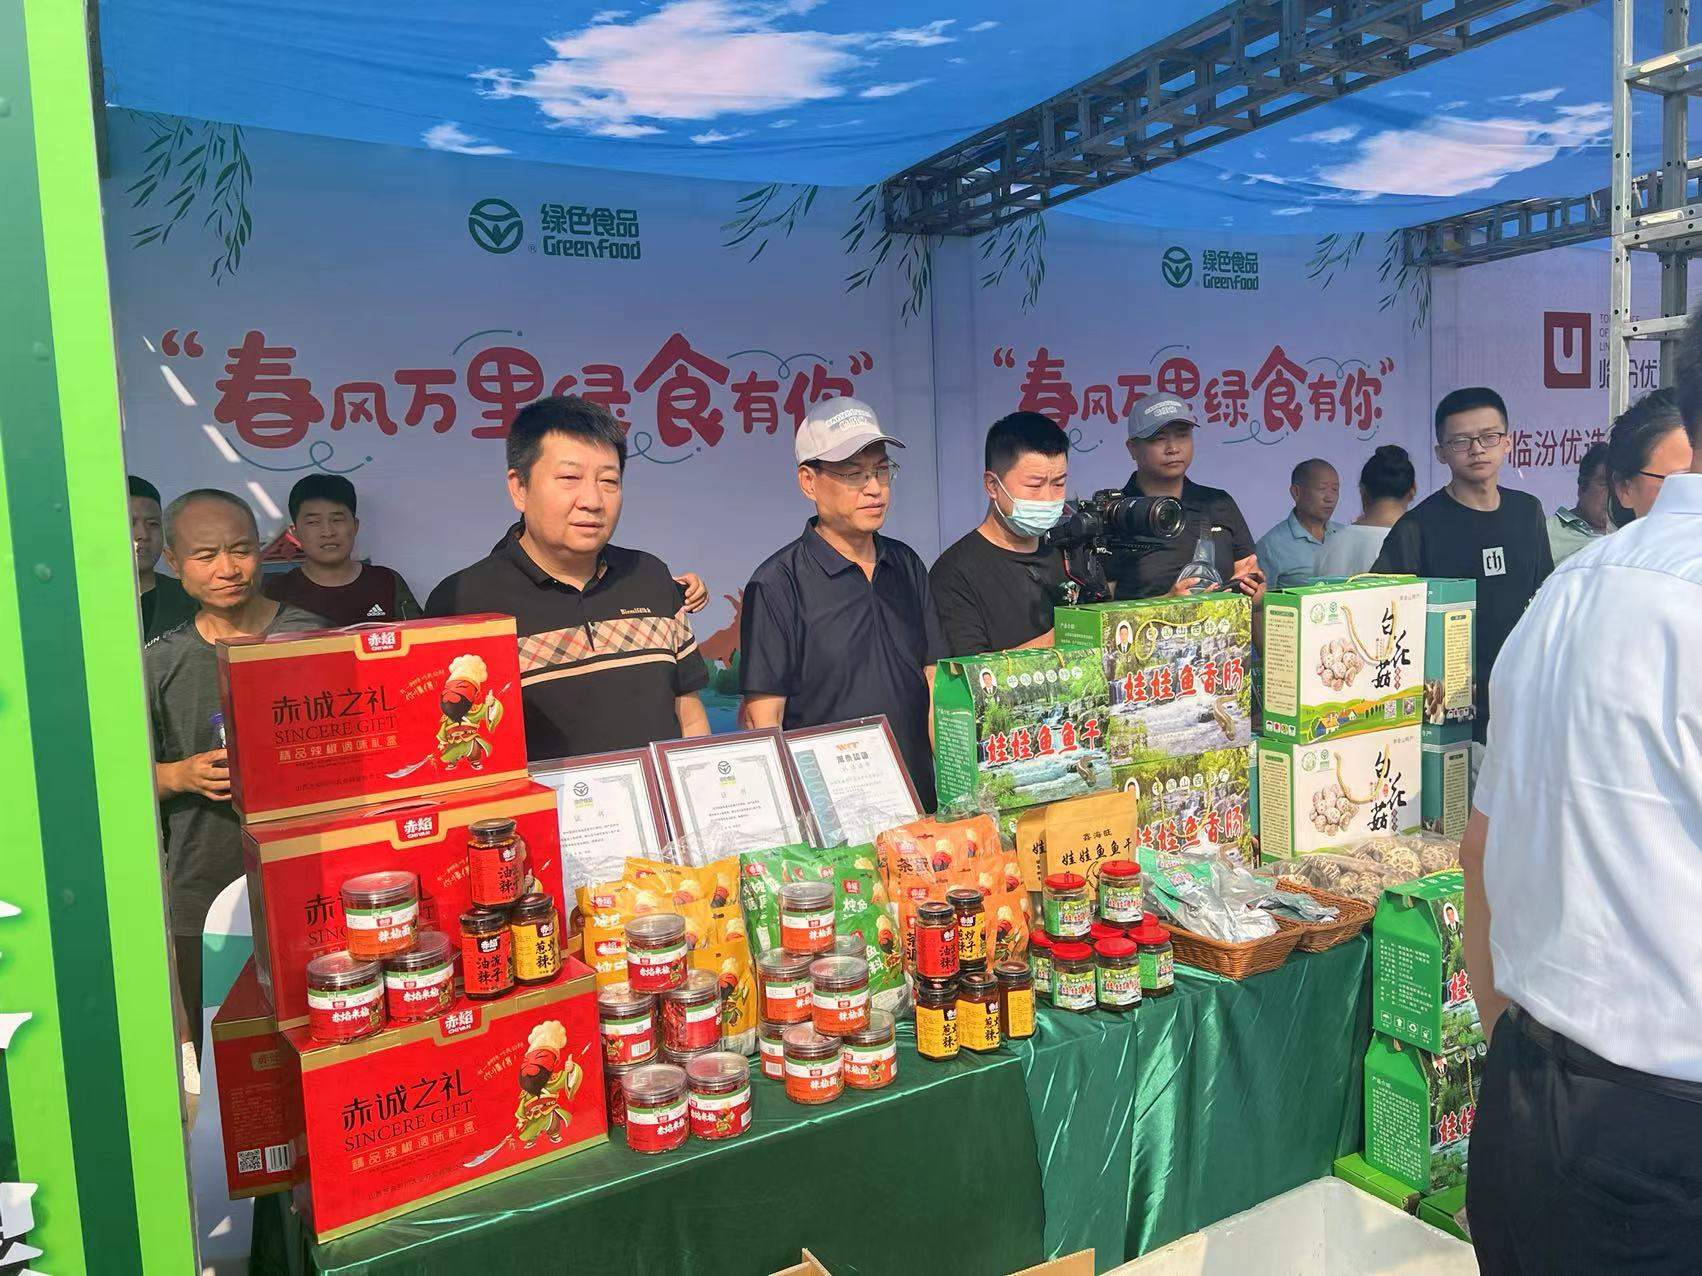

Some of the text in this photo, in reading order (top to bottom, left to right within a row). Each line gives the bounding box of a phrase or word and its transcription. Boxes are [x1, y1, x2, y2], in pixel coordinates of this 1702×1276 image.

[540, 203, 640, 238] 绿色食品
[1203, 250, 1259, 274] 绿色食品
[1123, 657, 1244, 705] 娃娃鱼香肠
[272, 685, 398, 726] 赤诚之礼
[275, 715, 398, 744] SINCERE GIFT
[986, 719, 1101, 767] 娃娃鱼鱼干
[1062, 837, 1132, 866] 娃娃鱼鱼干
[444, 1009, 474, 1028] 赤焰
[341, 1069, 472, 1132] 赤诚之礼
[345, 1098, 473, 1152] SINCERE GIFT
